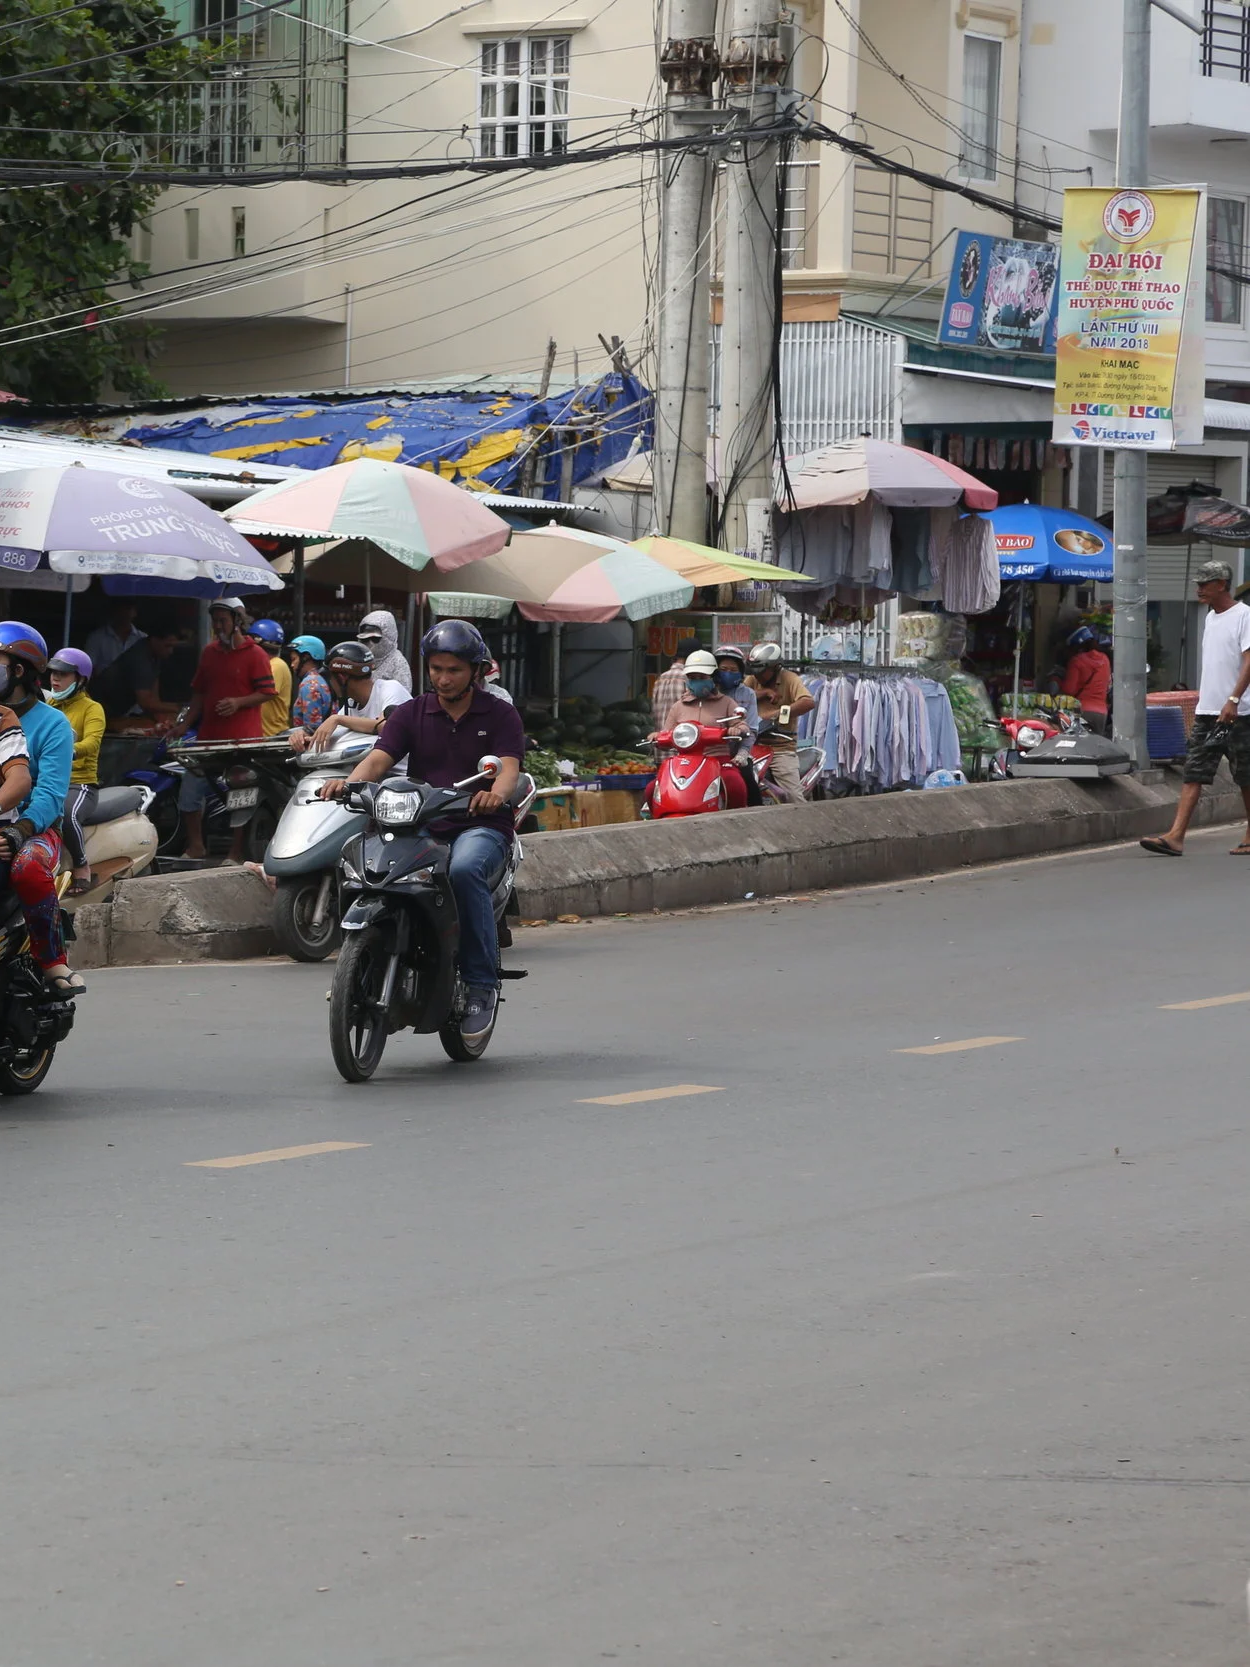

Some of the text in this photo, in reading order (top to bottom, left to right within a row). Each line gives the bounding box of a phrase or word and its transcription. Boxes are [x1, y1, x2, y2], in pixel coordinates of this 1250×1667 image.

[1088, 250, 1163, 274] ĐẠI HỘI
[1095, 281, 1118, 293] DỤC
[1145, 282, 1180, 294] THAO
[1069, 295, 1174, 311] HUYỆN PHÚ QUỐC
[1110, 319, 1139, 334] THỨ
[1141, 323, 1159, 335] VIII
[1120, 337, 1149, 349] 2018
[1100, 359, 1140, 371] KHAI MẠC
[1092, 426, 1155, 441] Vietravel
[0, 501, 31, 509] KHOA
[90, 508, 143, 527] PHÒNG
[98, 515, 186, 543] TRUNG
[2, 552, 26, 566] 888
[1015, 565, 1034, 576] 450
